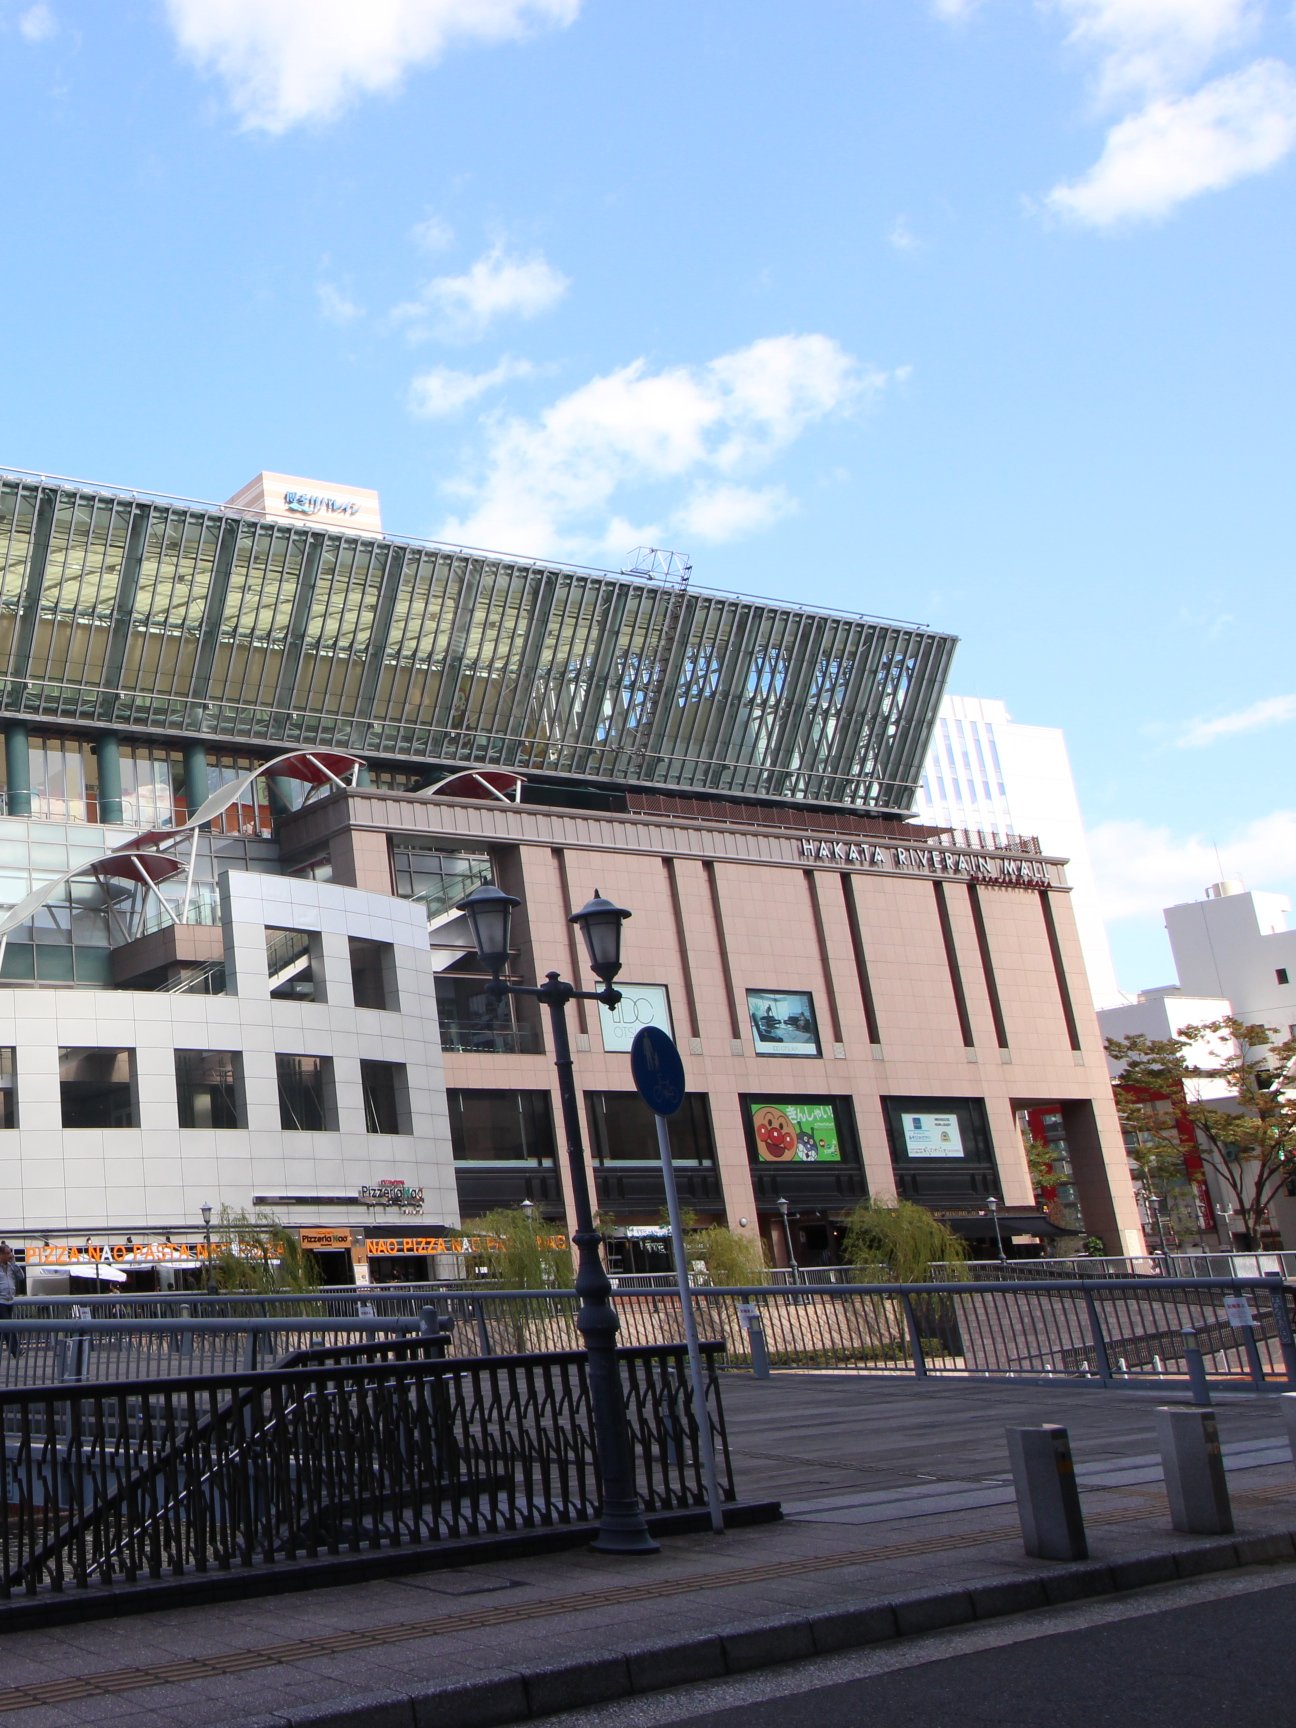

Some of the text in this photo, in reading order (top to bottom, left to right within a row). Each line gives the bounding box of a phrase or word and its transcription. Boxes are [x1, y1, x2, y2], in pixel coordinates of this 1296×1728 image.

[801, 839, 1051, 879] HAKATA RIVERAIN MALL
[25, 1245, 81, 1264] PIZZA
[88, 1245, 127, 1263] NAO
[133, 1243, 190, 1261] PASTA
[367, 1239, 398, 1254] NAO
[403, 1237, 447, 1254] PIZZA
